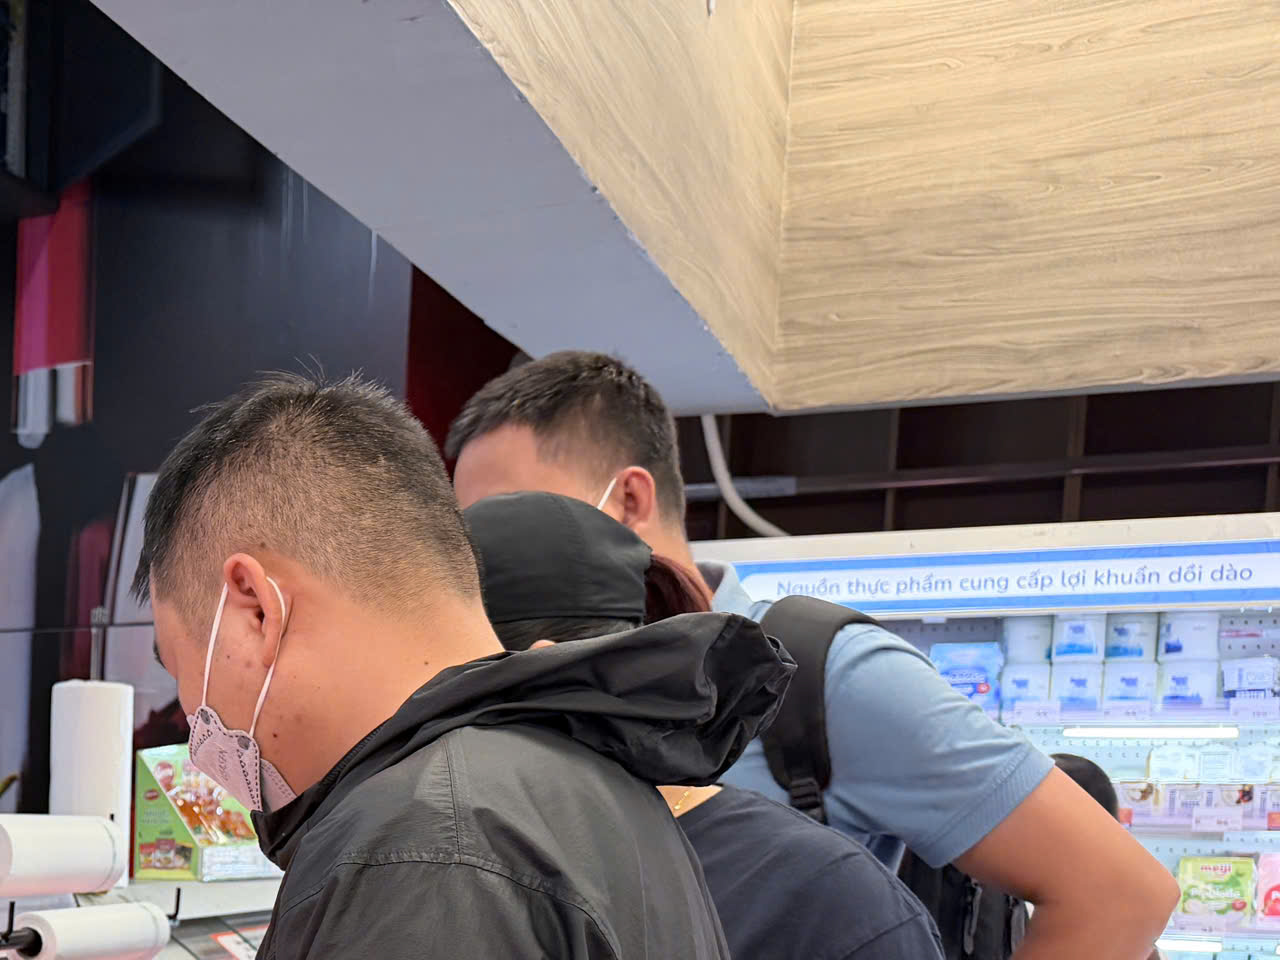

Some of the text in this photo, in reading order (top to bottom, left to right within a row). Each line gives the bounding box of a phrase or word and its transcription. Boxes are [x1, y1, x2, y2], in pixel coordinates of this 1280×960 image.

[847, 577, 889, 595] thực
[896, 573, 952, 594] phẩm
[960, 577, 1009, 593] cung
[1016, 568, 1053, 591] cấp
[1061, 569, 1086, 590] lợi
[1094, 565, 1160, 585] khuẩn
[1169, 563, 1202, 583] dồi
[1210, 563, 1253, 581] dào
